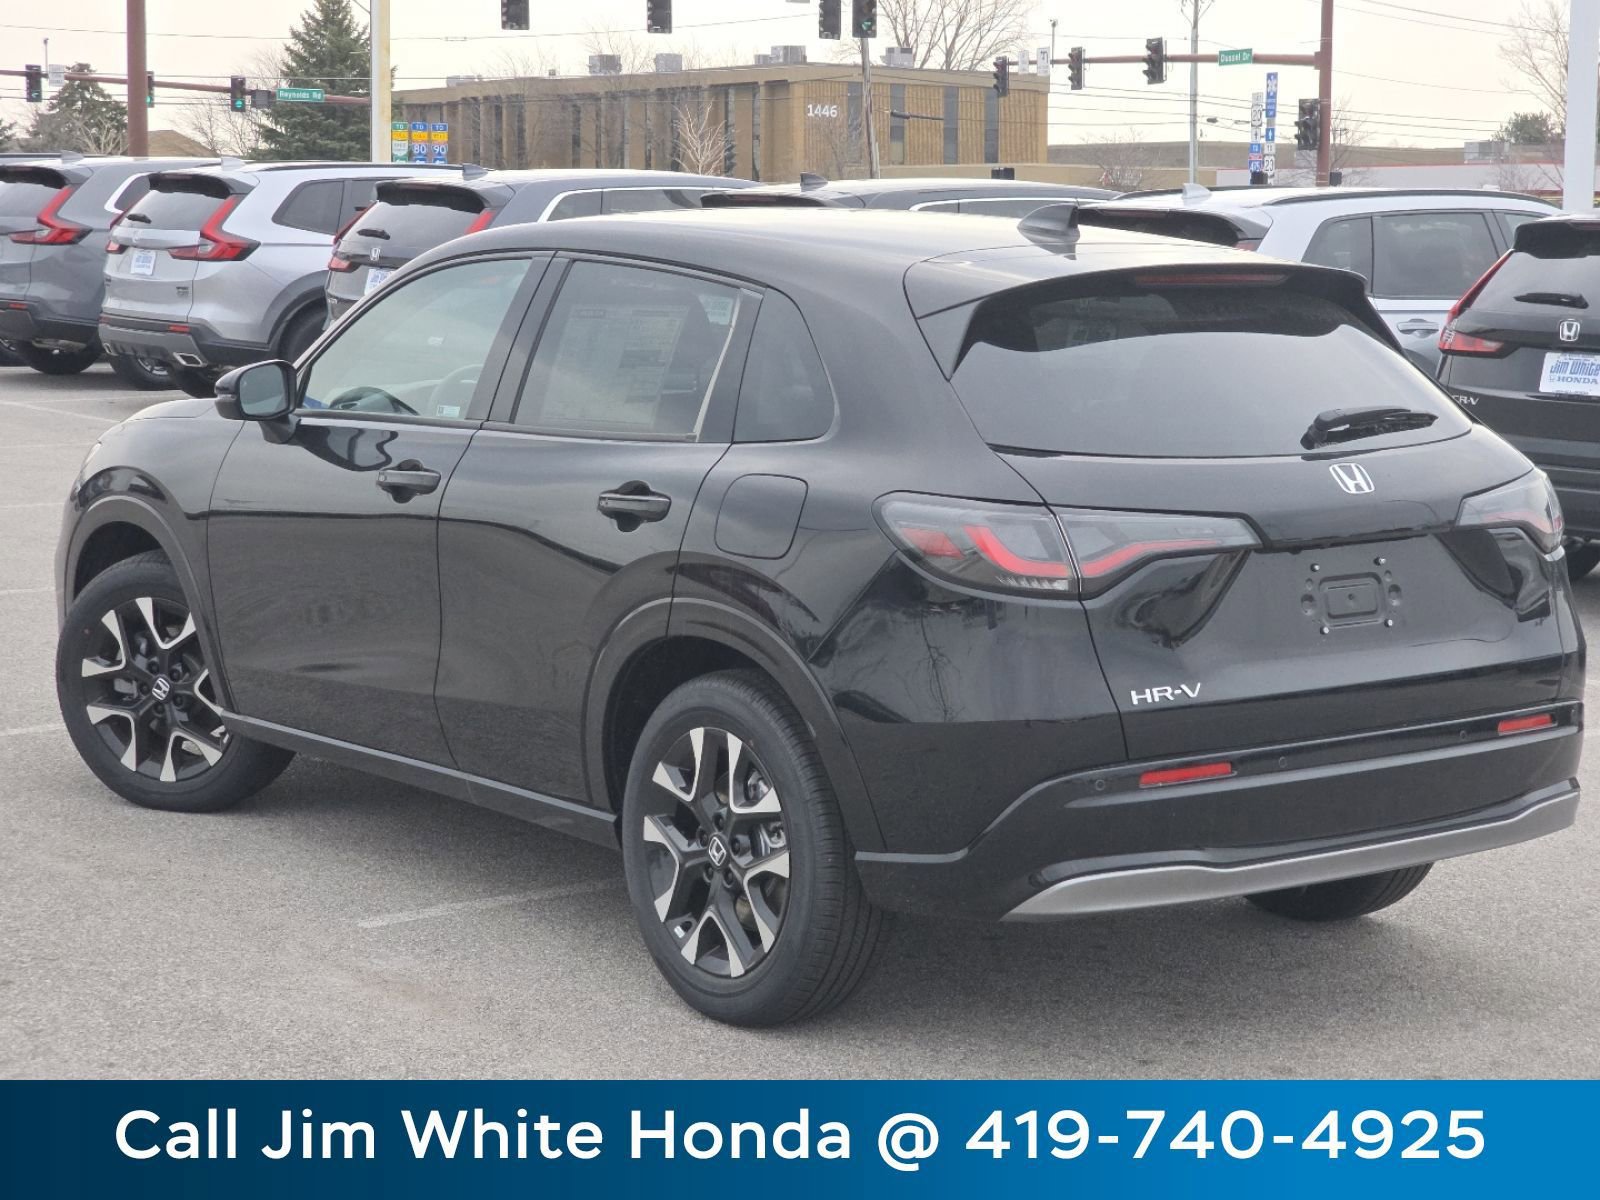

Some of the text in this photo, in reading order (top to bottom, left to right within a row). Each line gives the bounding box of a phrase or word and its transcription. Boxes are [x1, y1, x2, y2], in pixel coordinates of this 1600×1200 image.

[279, 90, 322, 99] Reynolds Rd
[807, 103, 838, 118] 1446
[413, 144, 427, 154] 80
[433, 145, 447, 155] 90
[1550, 360, 1600, 377] Jim White
[1556, 376, 1599, 385] HONDA
[1130, 681, 1202, 705] HR-V
